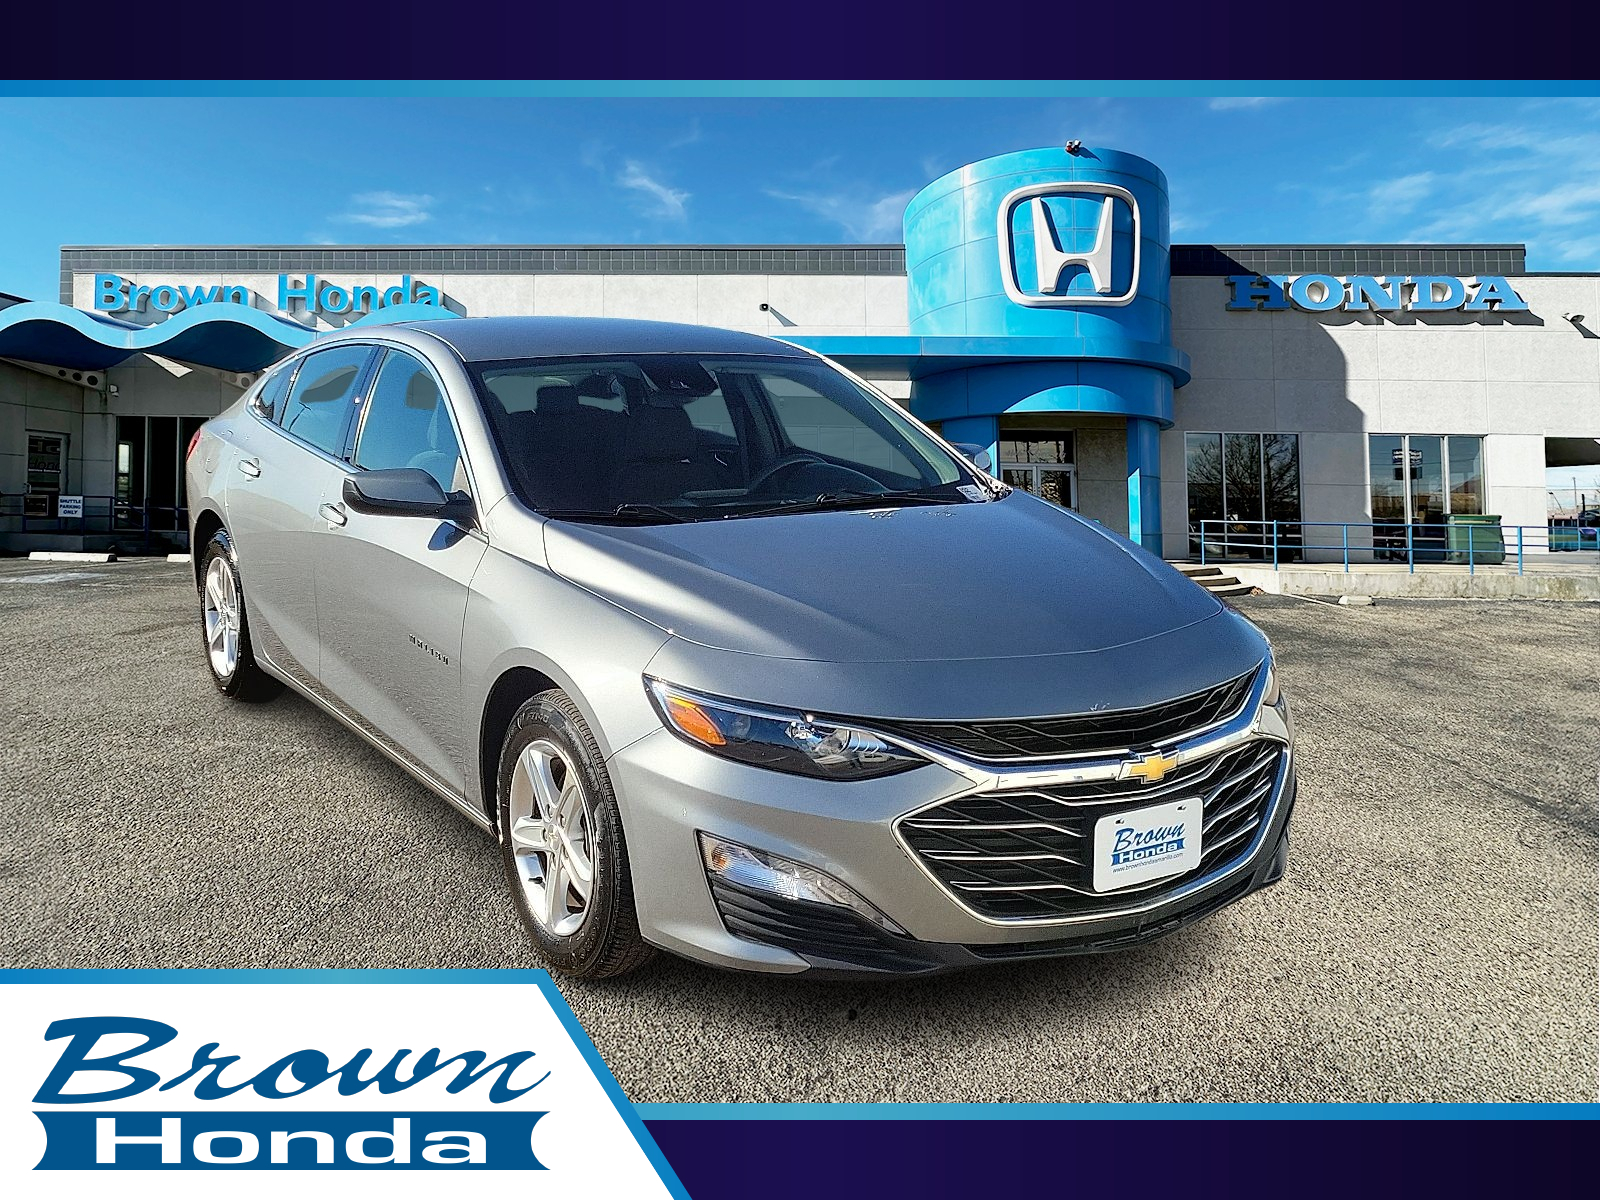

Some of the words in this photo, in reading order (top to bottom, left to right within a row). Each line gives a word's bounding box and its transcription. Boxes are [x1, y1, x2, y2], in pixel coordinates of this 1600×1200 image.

[94, 273, 249, 312] Brown
[278, 273, 440, 313] Honda
[1226, 274, 1529, 312] HONDA
[1113, 823, 1186, 853] Brown
[1119, 842, 1178, 864] Honda
